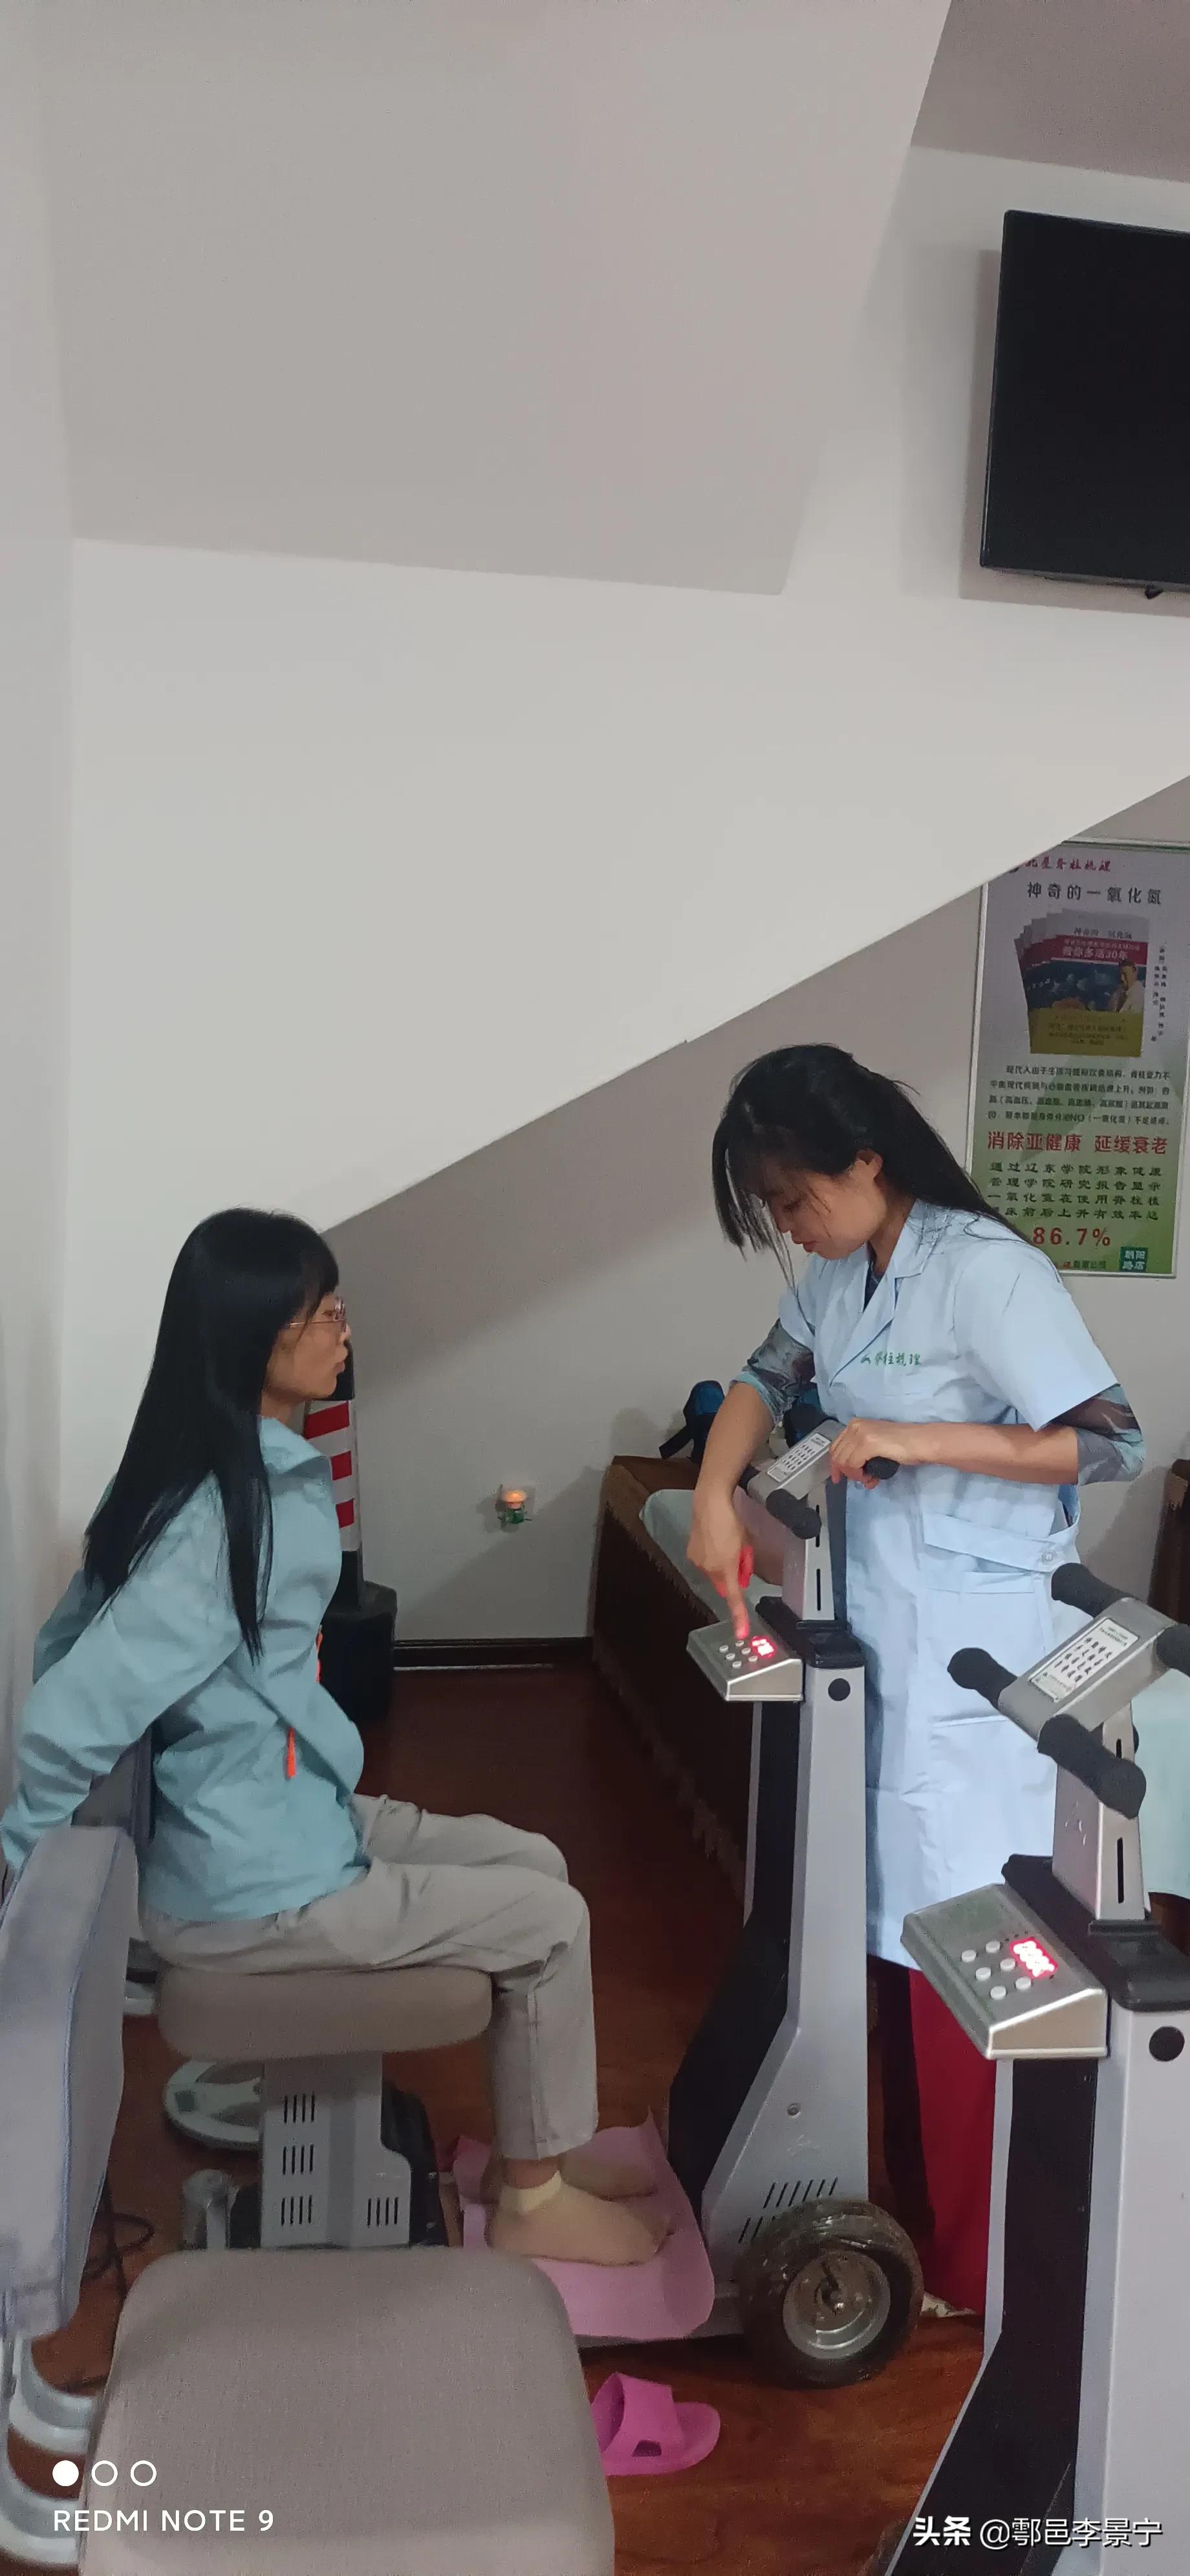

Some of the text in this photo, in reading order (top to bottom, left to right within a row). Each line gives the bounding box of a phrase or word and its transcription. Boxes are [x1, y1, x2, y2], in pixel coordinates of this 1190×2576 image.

[1027, 881, 1161, 905] 神奇的一氧化氮
[988, 1131, 1168, 1154] 消除亚健康 延缓衰老
[990, 1162, 1162, 1176] 通过辽东学院形象健康
[990, 1177, 1161, 1191] 管理学院研究报告显示
[994, 1207, 1158, 1220] 床前后上升有效率达
[1033, 1227, 1110, 1246] 86.7%
